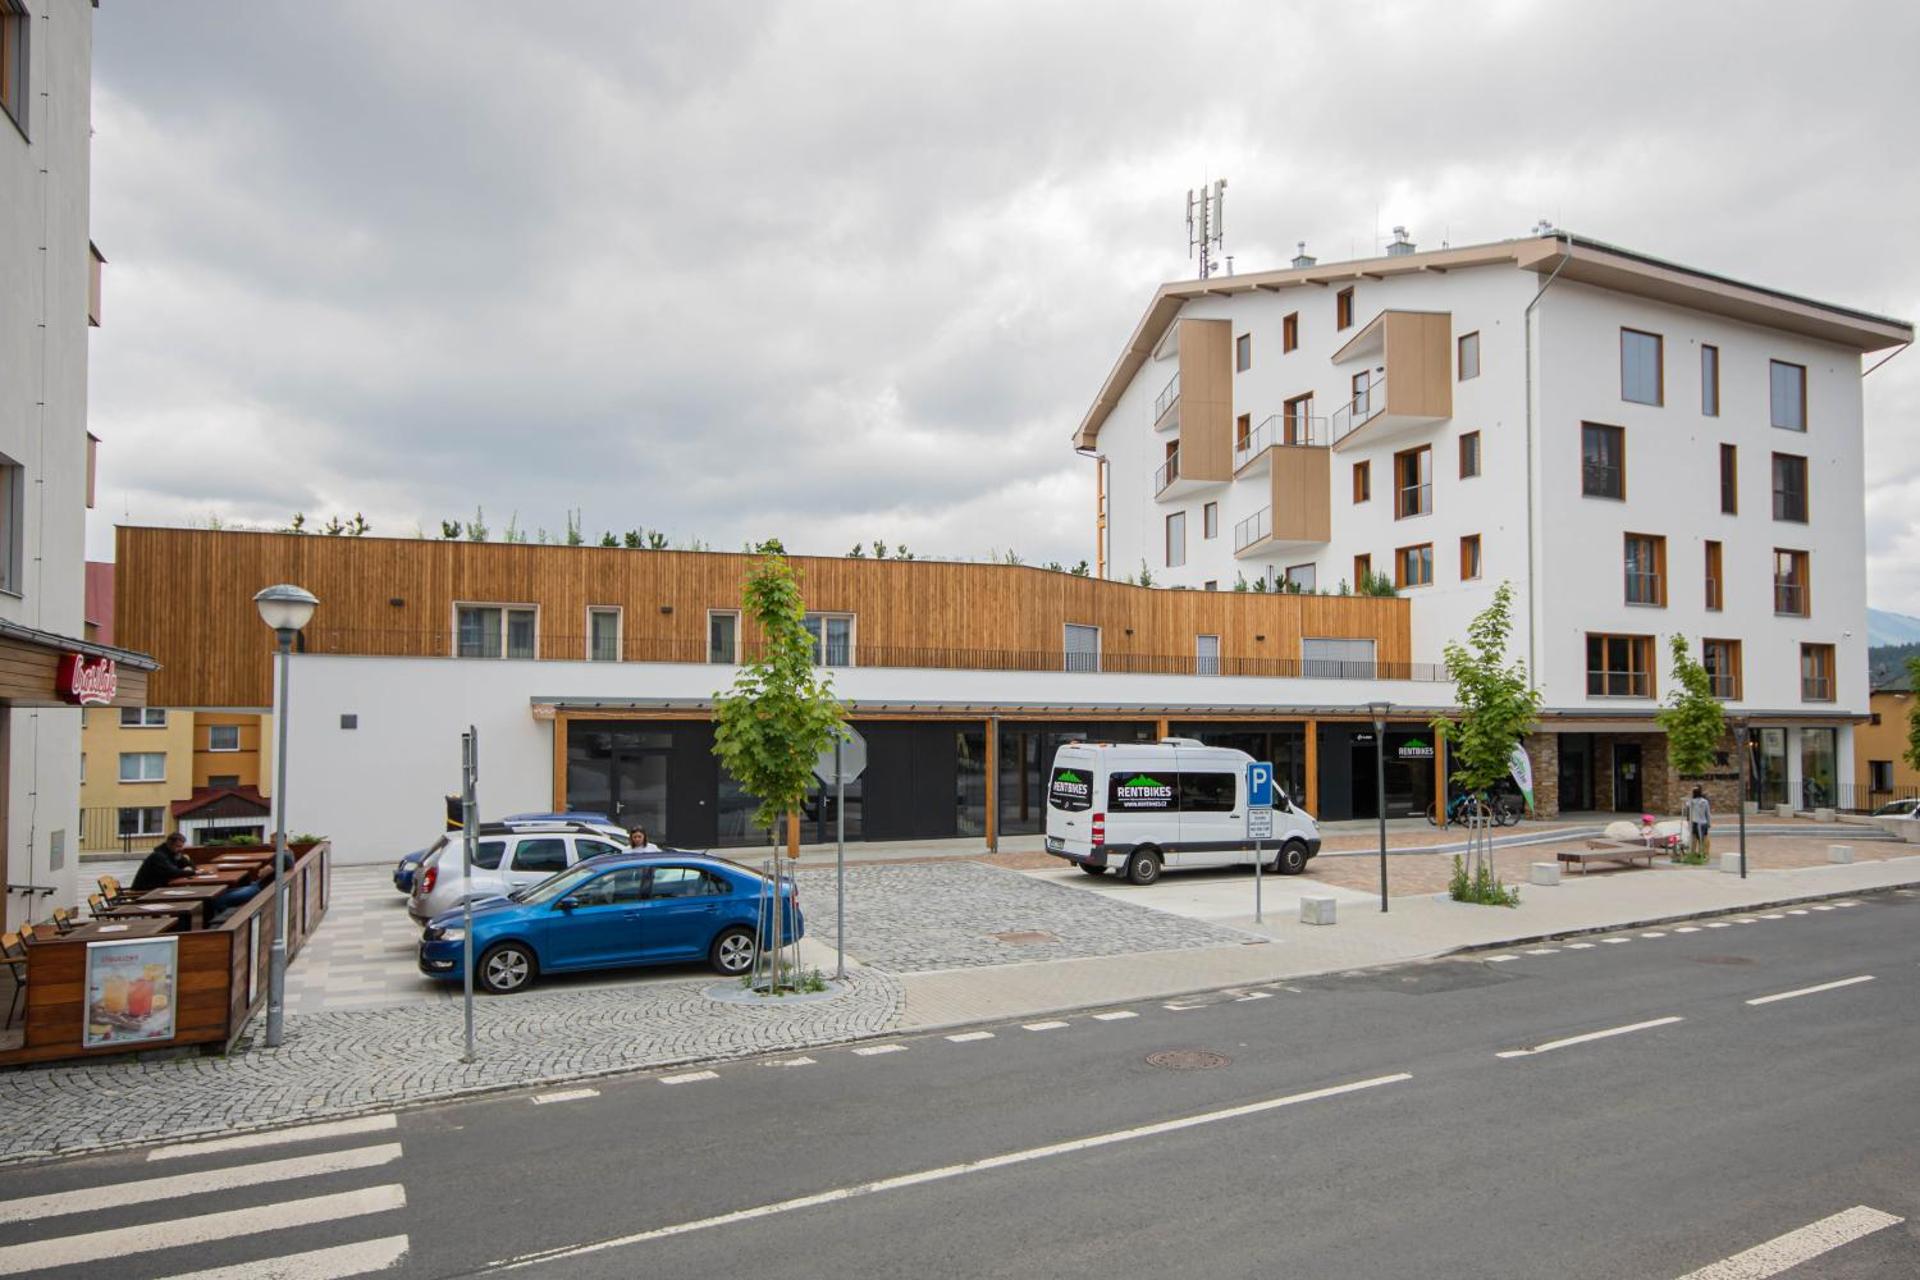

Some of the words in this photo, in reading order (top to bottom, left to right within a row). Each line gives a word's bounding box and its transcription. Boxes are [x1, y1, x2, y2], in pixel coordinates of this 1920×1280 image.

[1398, 747, 1434, 755] RENTBIKES
[1253, 768, 1267, 793] P
[1053, 781, 1088, 794] RENTBIKES
[1117, 786, 1172, 797] RENTBIKES
